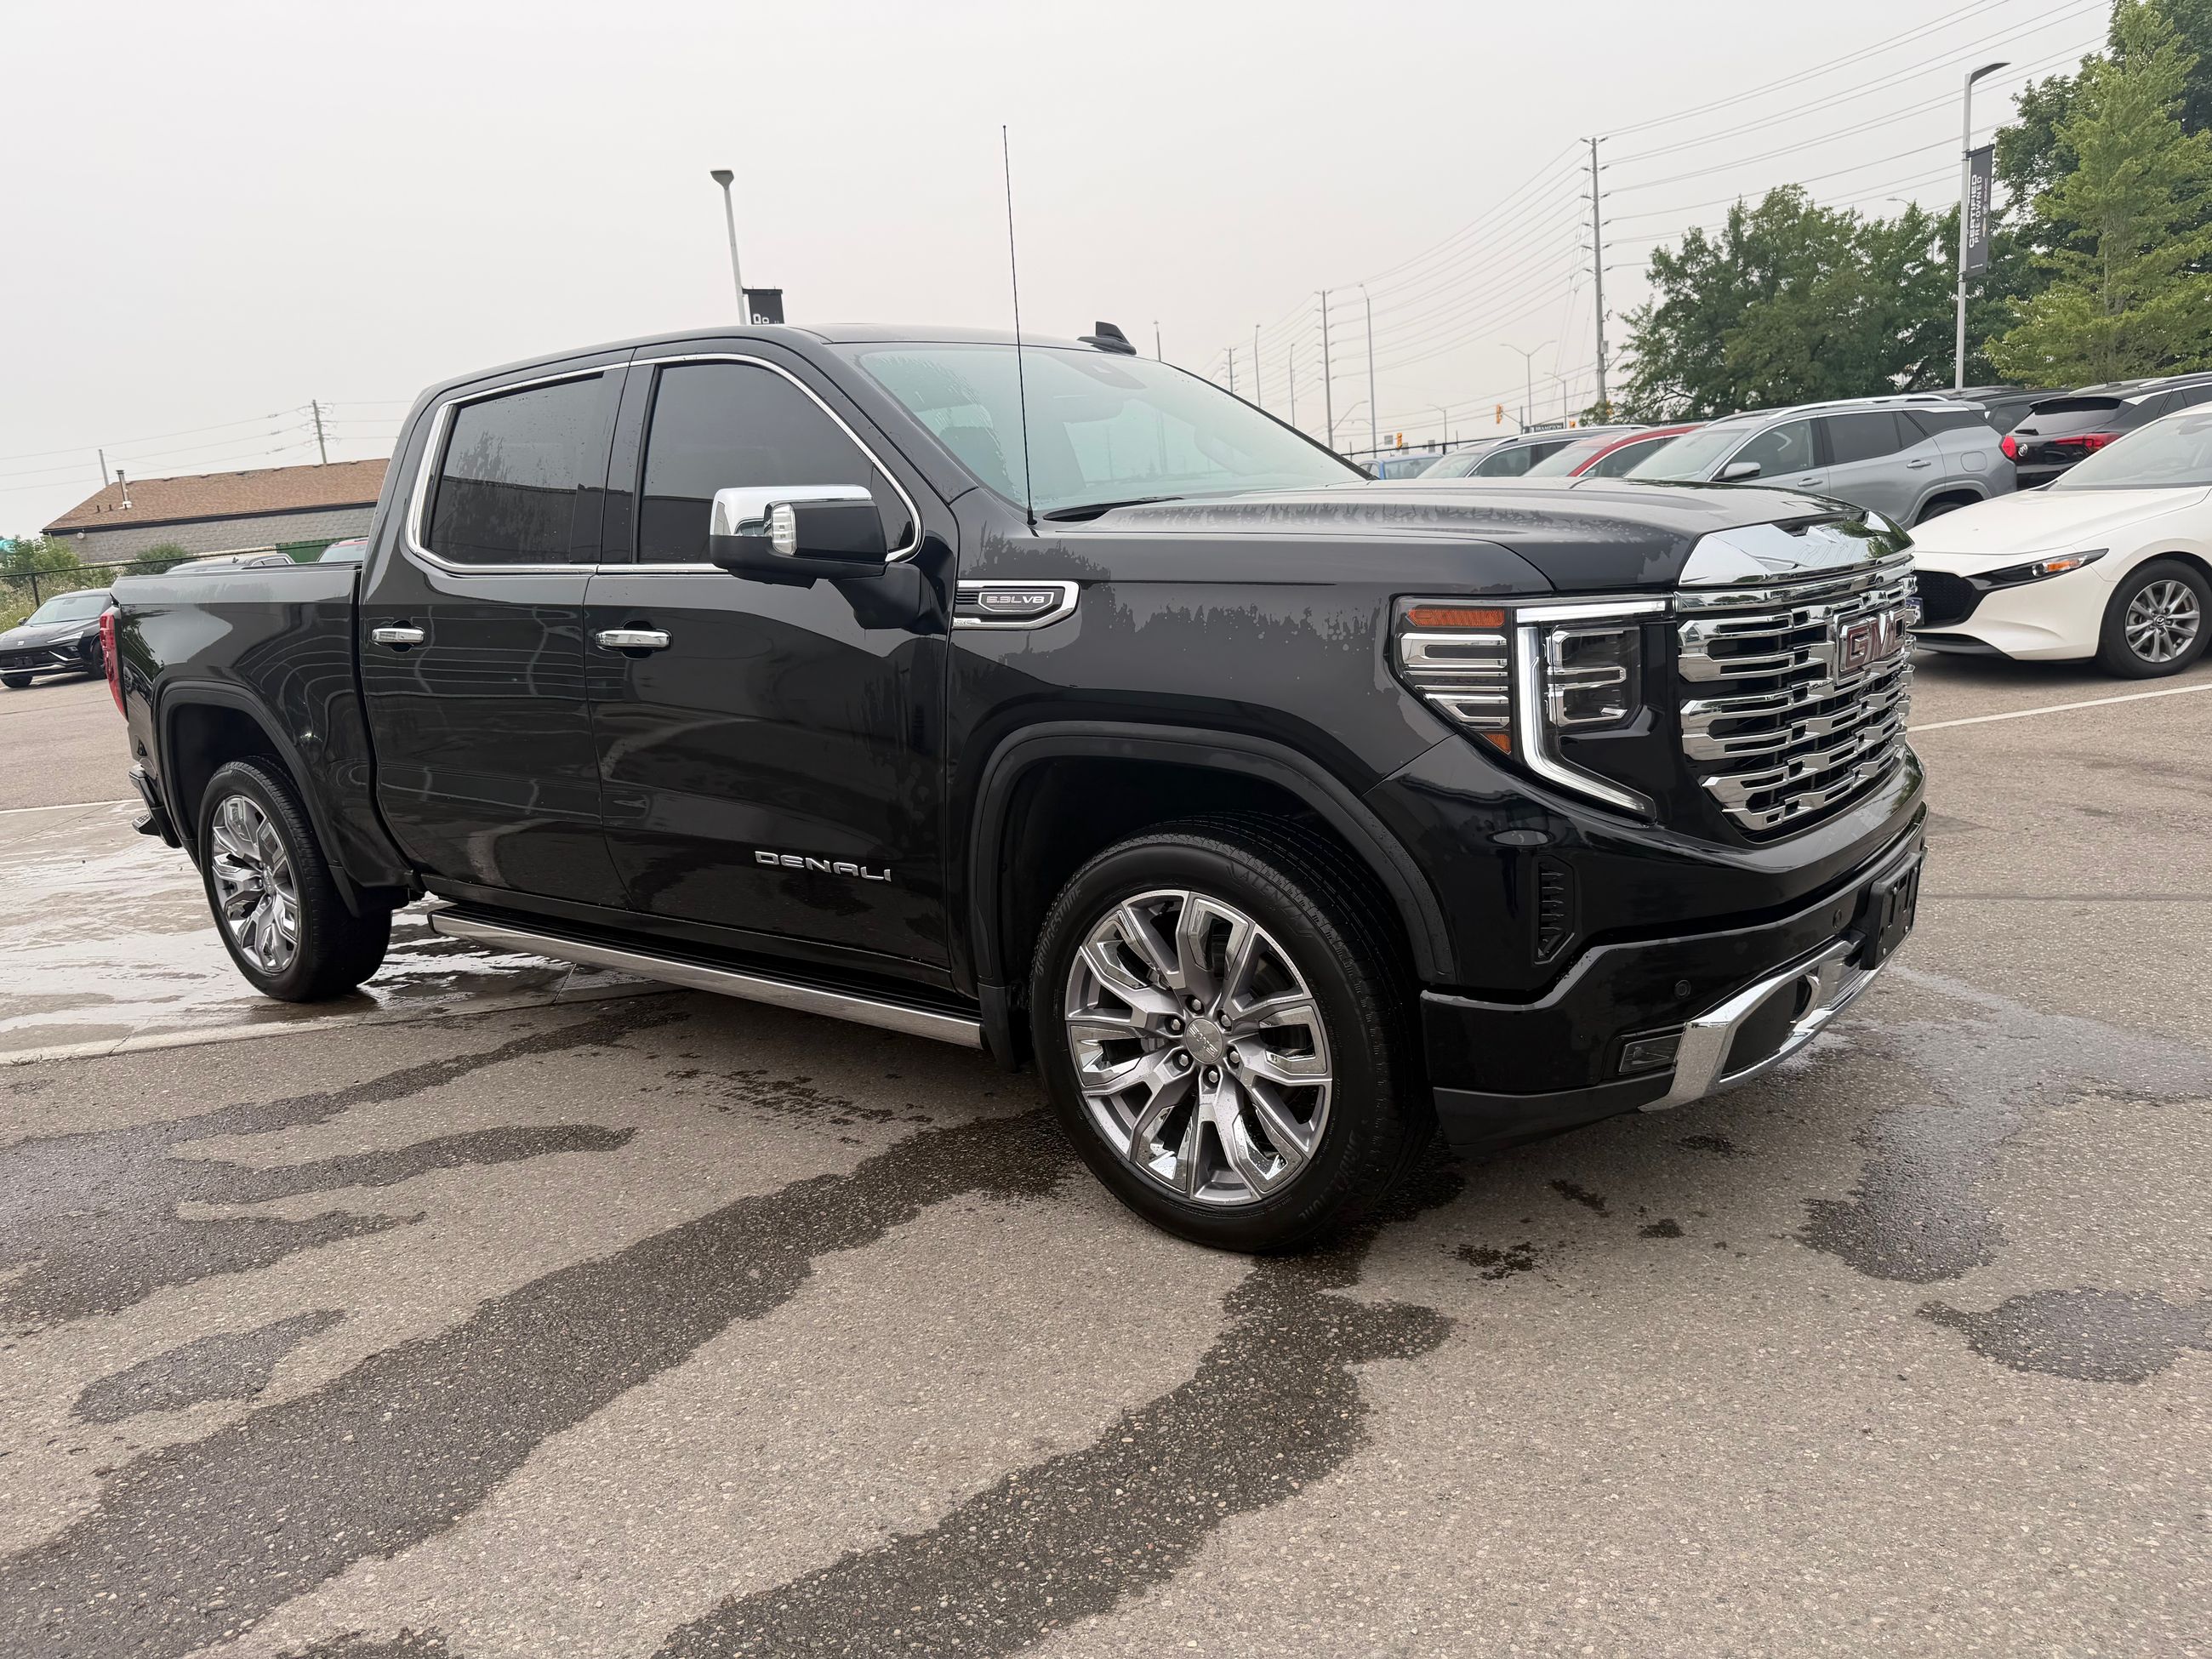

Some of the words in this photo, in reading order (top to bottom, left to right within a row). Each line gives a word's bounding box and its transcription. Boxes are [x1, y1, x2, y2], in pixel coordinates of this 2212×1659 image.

[1969, 174, 1977, 248] CERTIFIED
[1974, 176, 1982, 243] PRE-OWNED
[1839, 609, 1907, 672] GMC
[755, 851, 892, 882] DENALI
[1226, 860, 1303, 926] VALENZA
